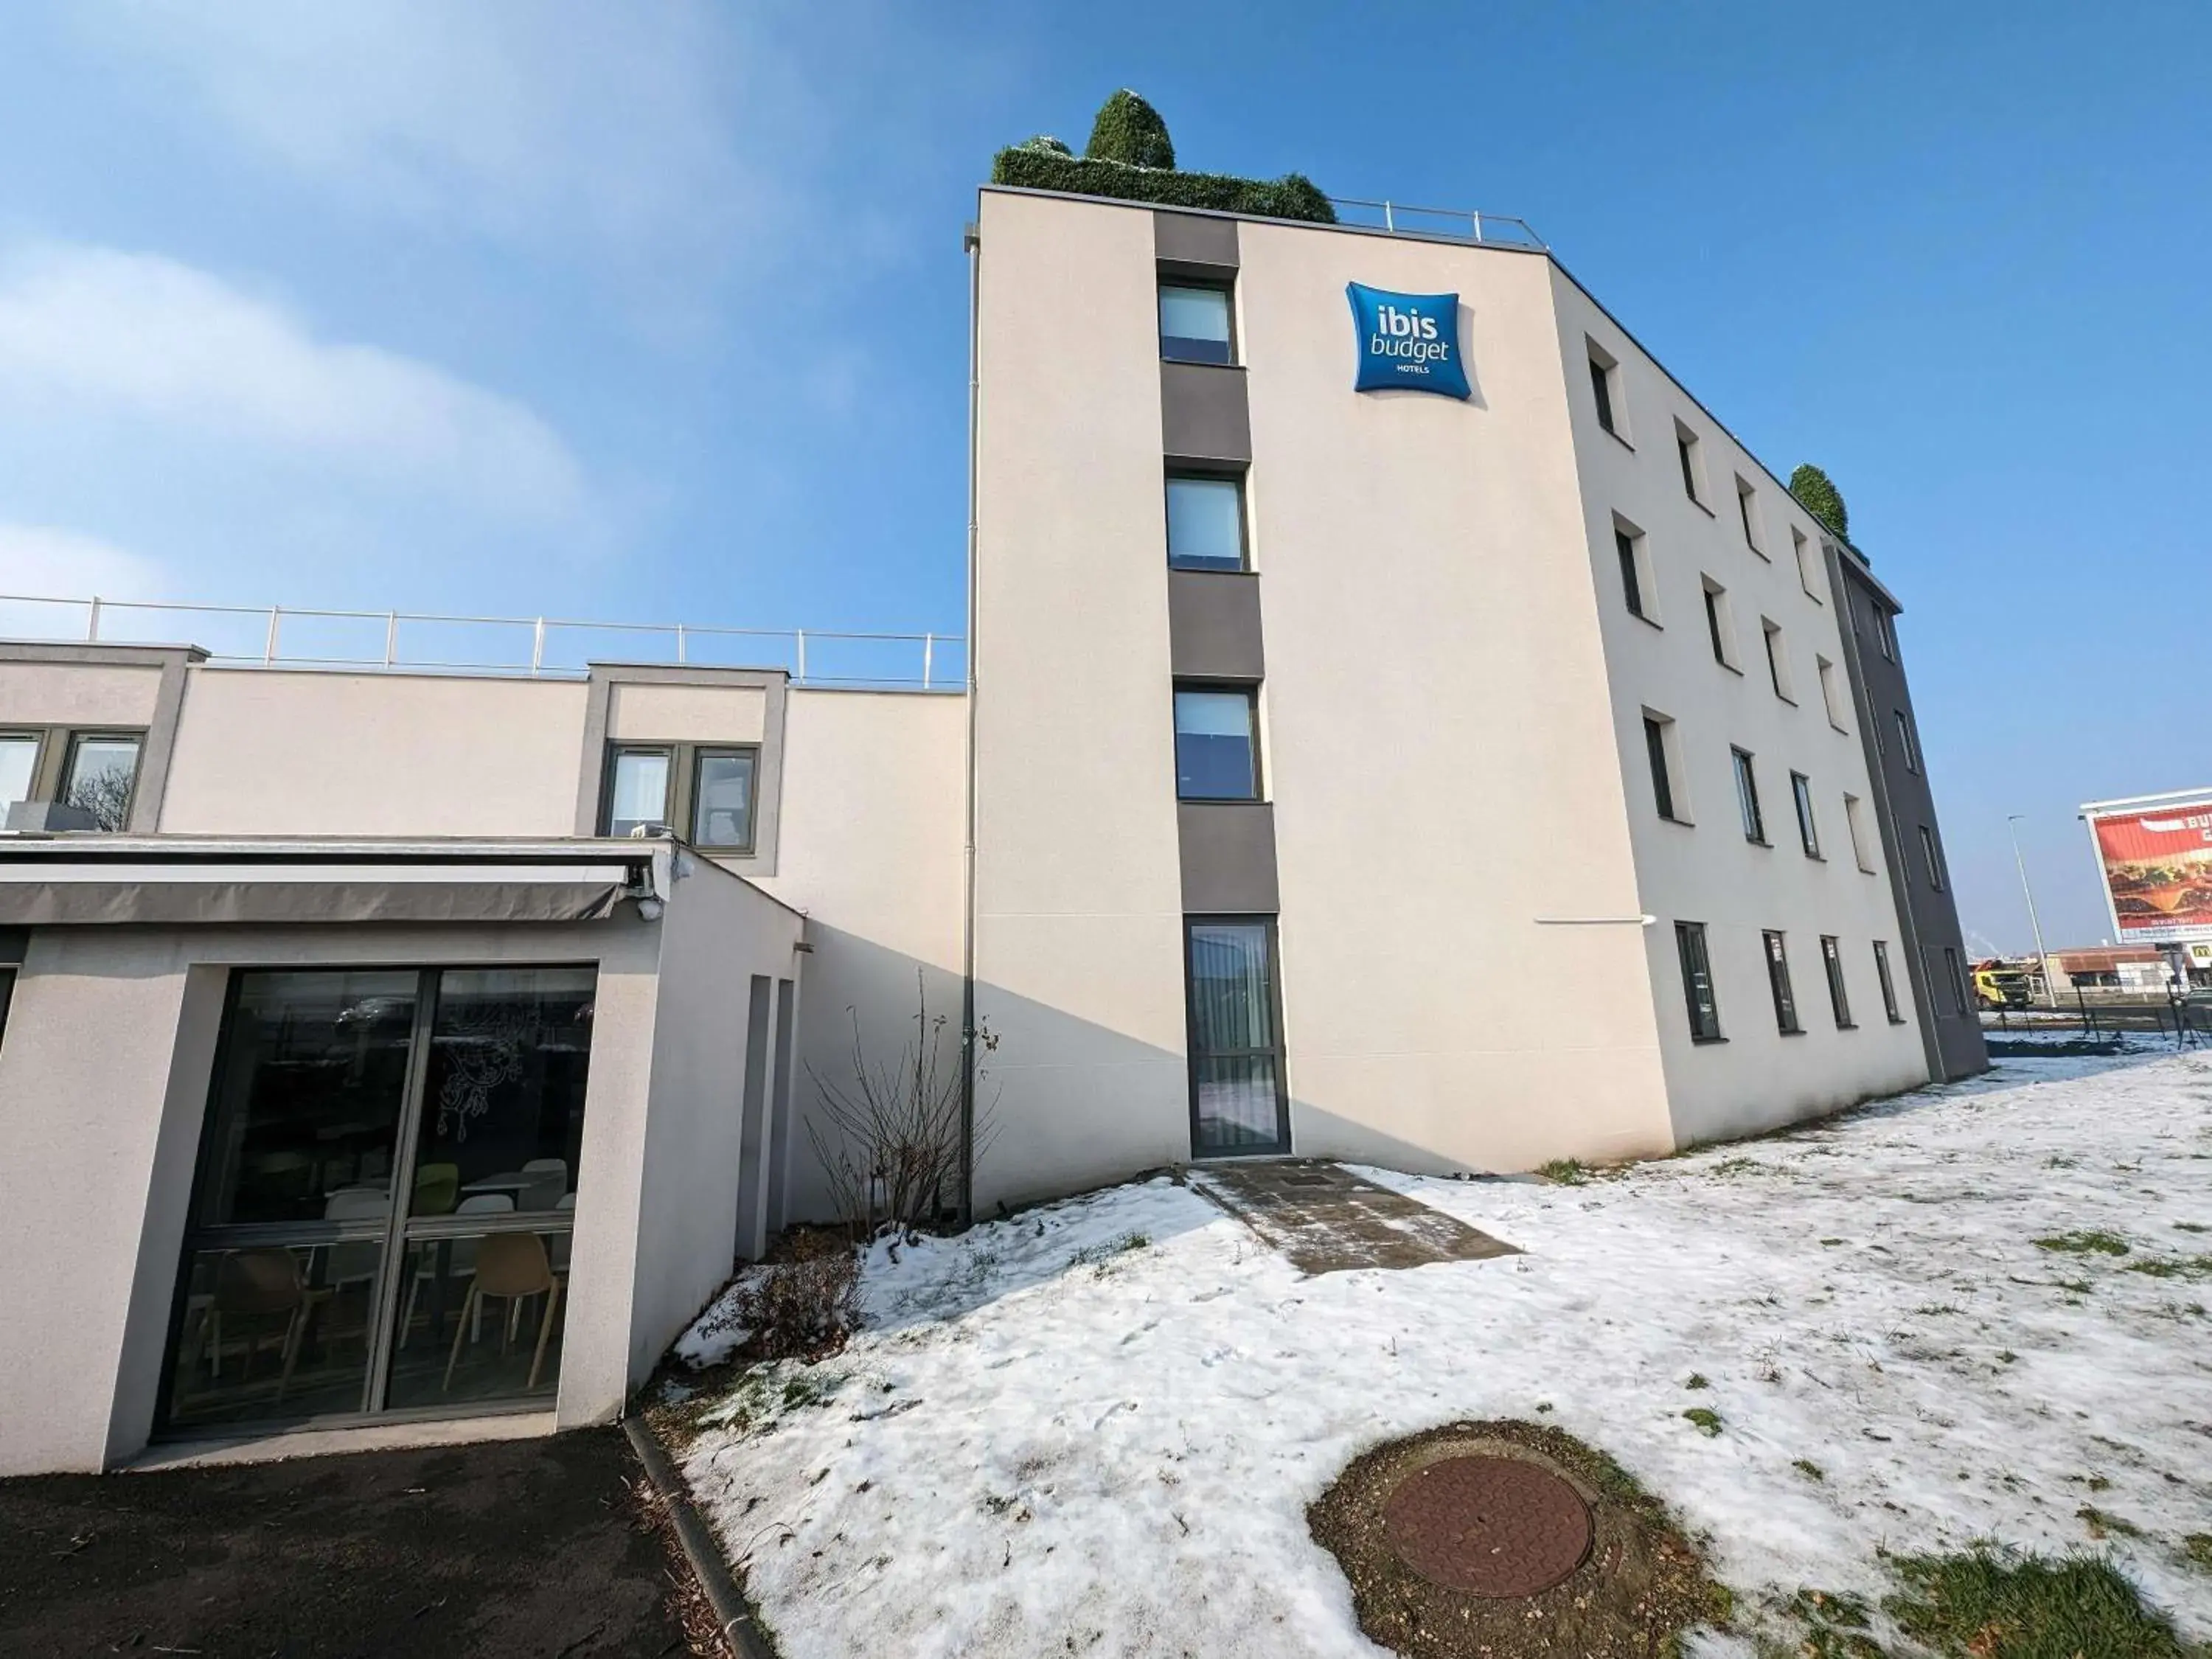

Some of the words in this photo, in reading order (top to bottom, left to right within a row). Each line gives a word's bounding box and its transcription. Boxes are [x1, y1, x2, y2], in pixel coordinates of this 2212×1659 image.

[1378, 305, 1438, 339] ibis
[1371, 333, 1450, 364] budget
[1397, 364, 1430, 374] HOTELS
